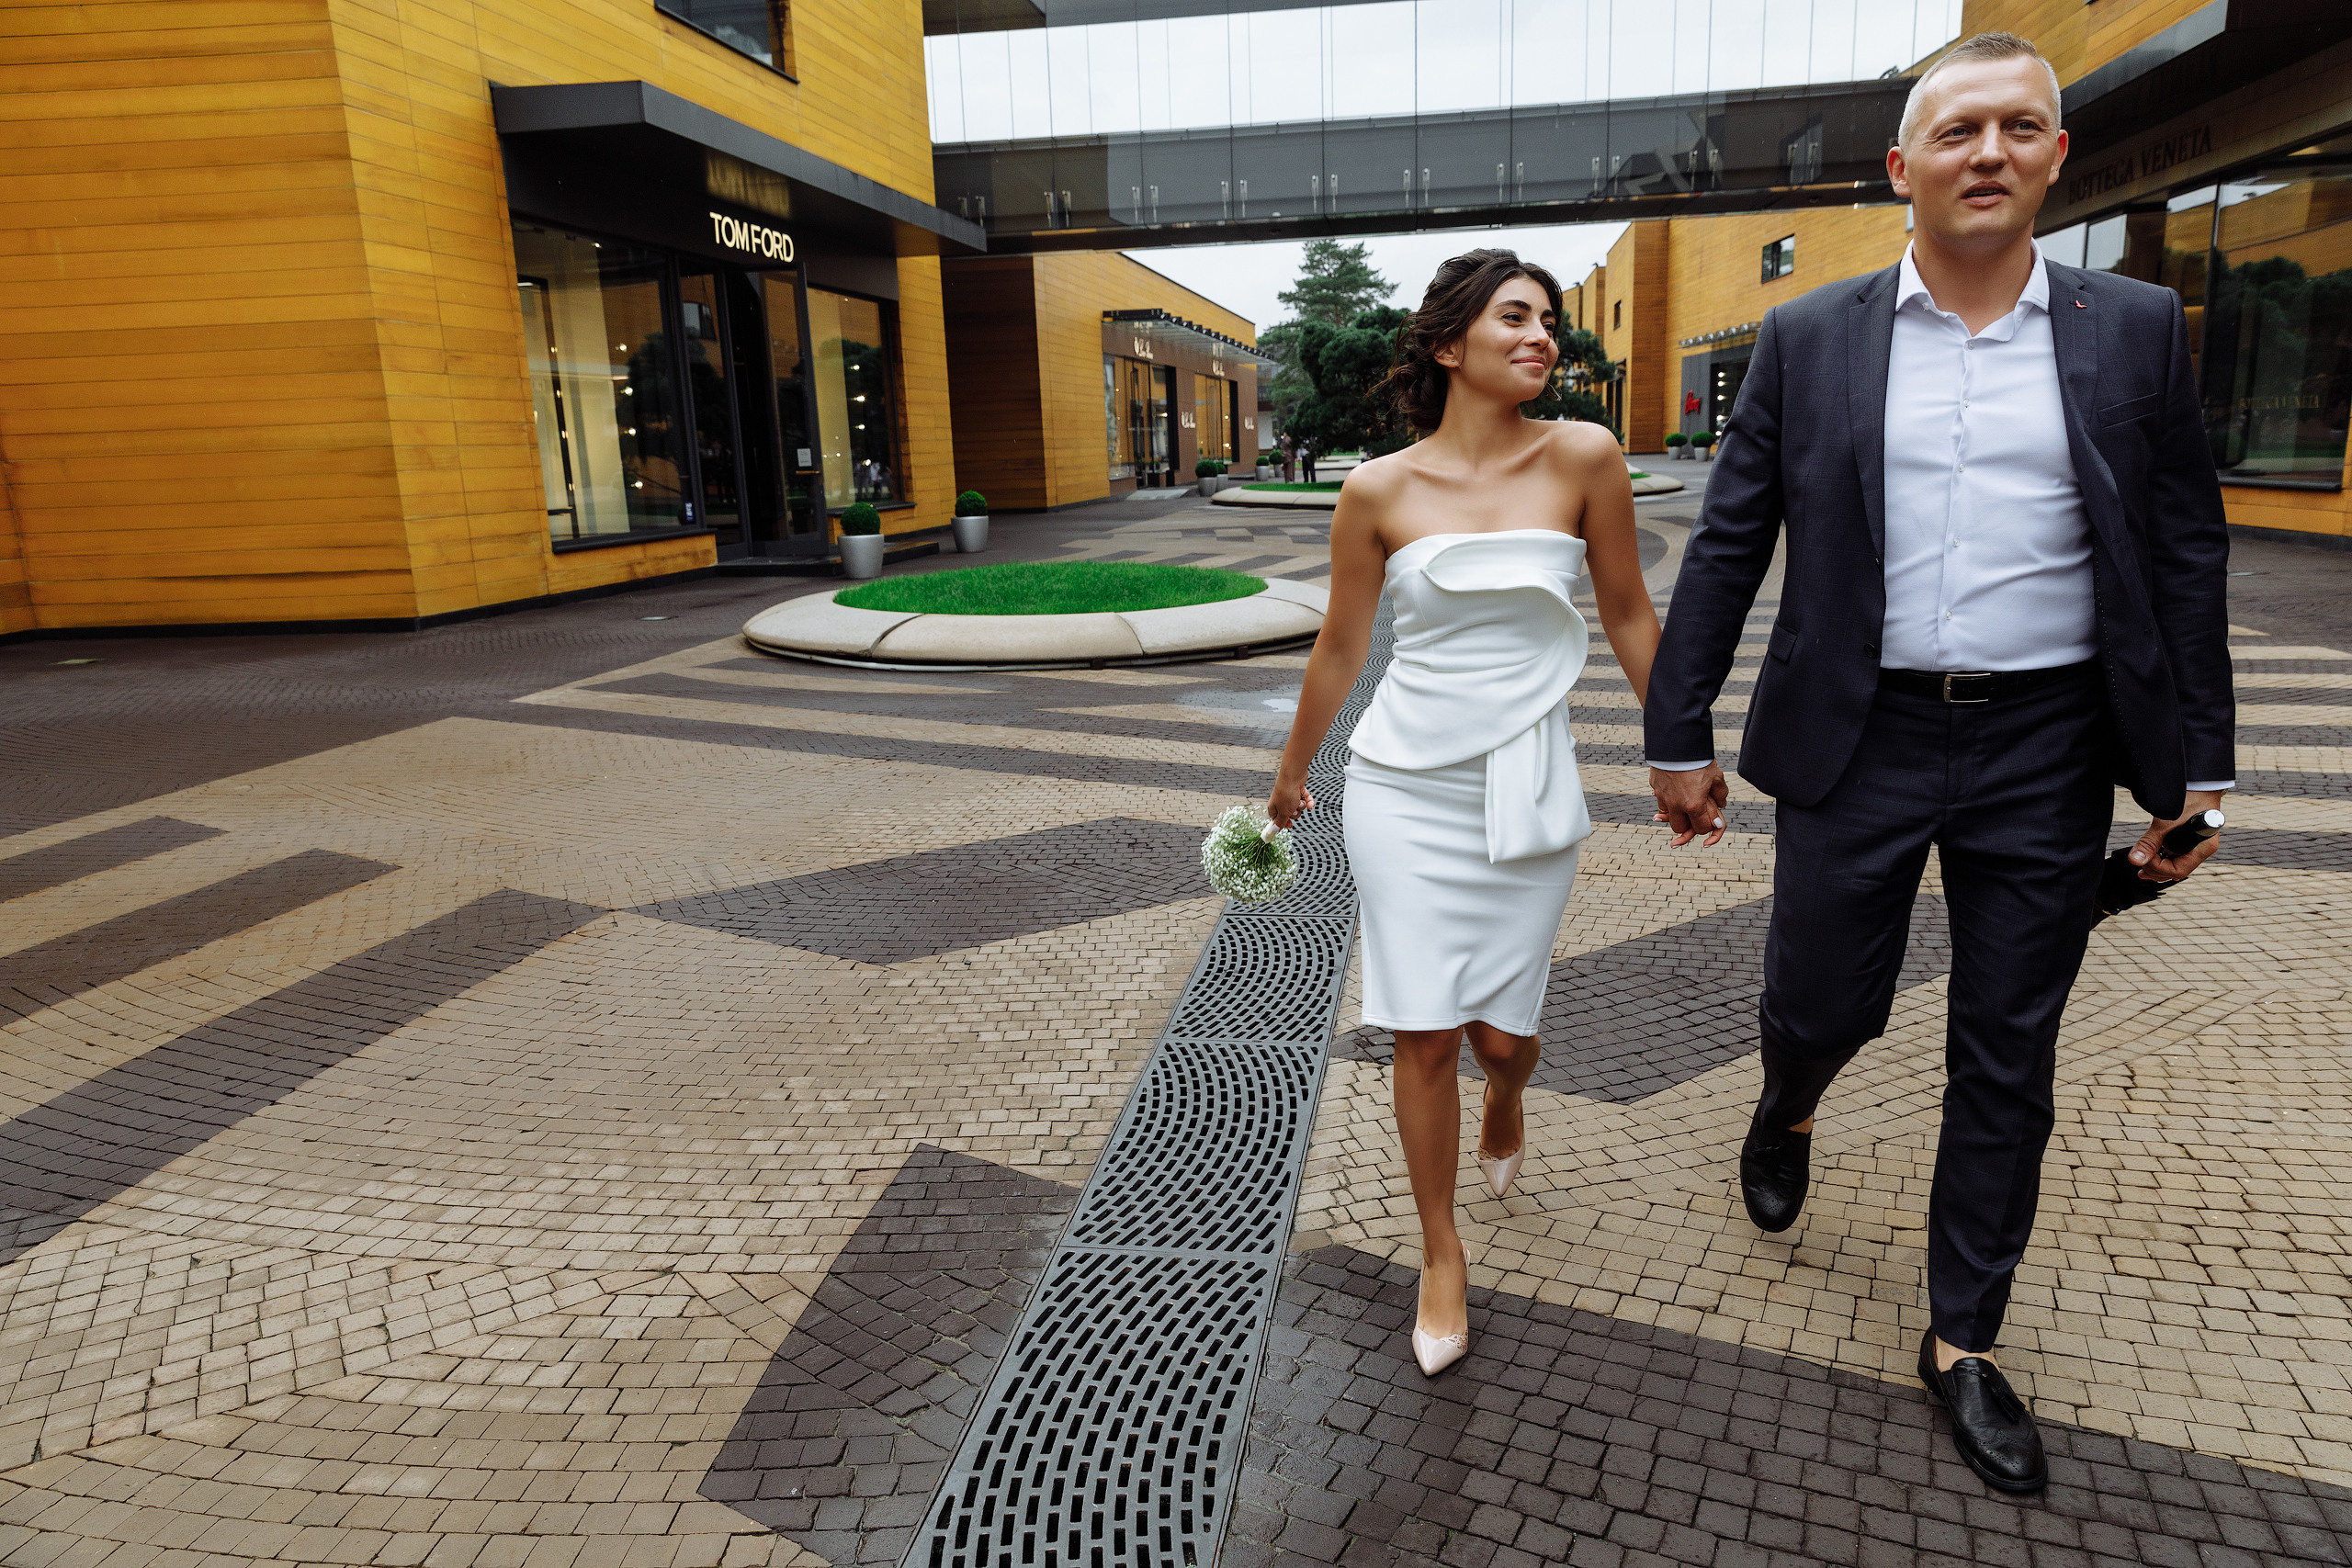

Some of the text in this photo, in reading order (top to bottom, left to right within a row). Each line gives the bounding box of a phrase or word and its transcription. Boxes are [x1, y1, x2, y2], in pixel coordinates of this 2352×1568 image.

[2068, 124, 2211, 204] BOTTEGA VENETA
[709, 211, 795, 263] TOM FORD
